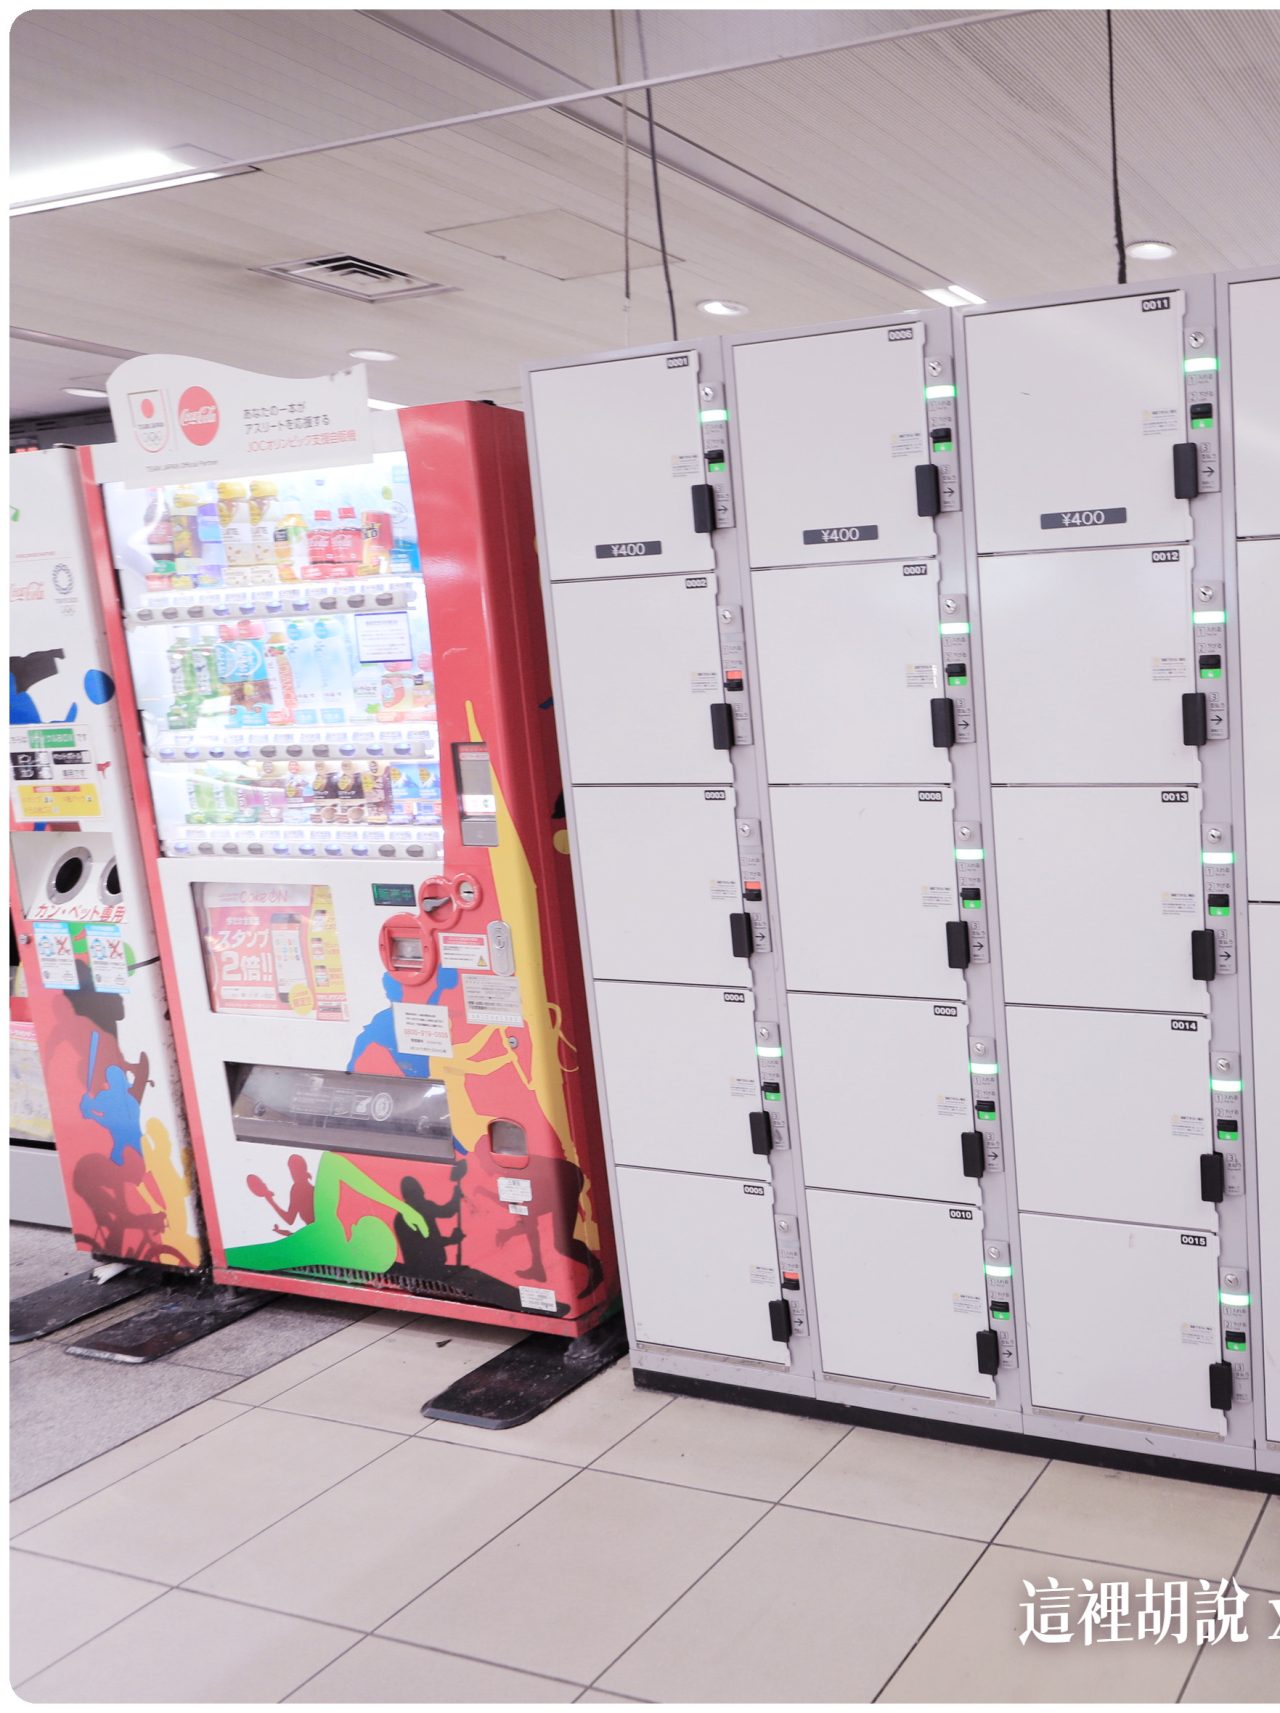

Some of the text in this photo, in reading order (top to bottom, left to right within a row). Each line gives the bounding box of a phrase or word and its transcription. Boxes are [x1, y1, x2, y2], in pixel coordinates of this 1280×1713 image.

[1143, 298, 1169, 311] 0011
[1062, 510, 1104, 527] ¥400
[822, 527, 859, 543] ¥400
[612, 542, 645, 557] ¥400
[1152, 551, 1179, 562] 0012
[903, 565, 927, 576] 0007
[1162, 792, 1188, 802] 0013
[218, 929, 270, 948] スタンプ
[934, 1006, 957, 1016] 0009
[1172, 1021, 1197, 1031] 0014
[949, 1210, 972, 1220] 0010
[1181, 1235, 1206, 1246] 0015
